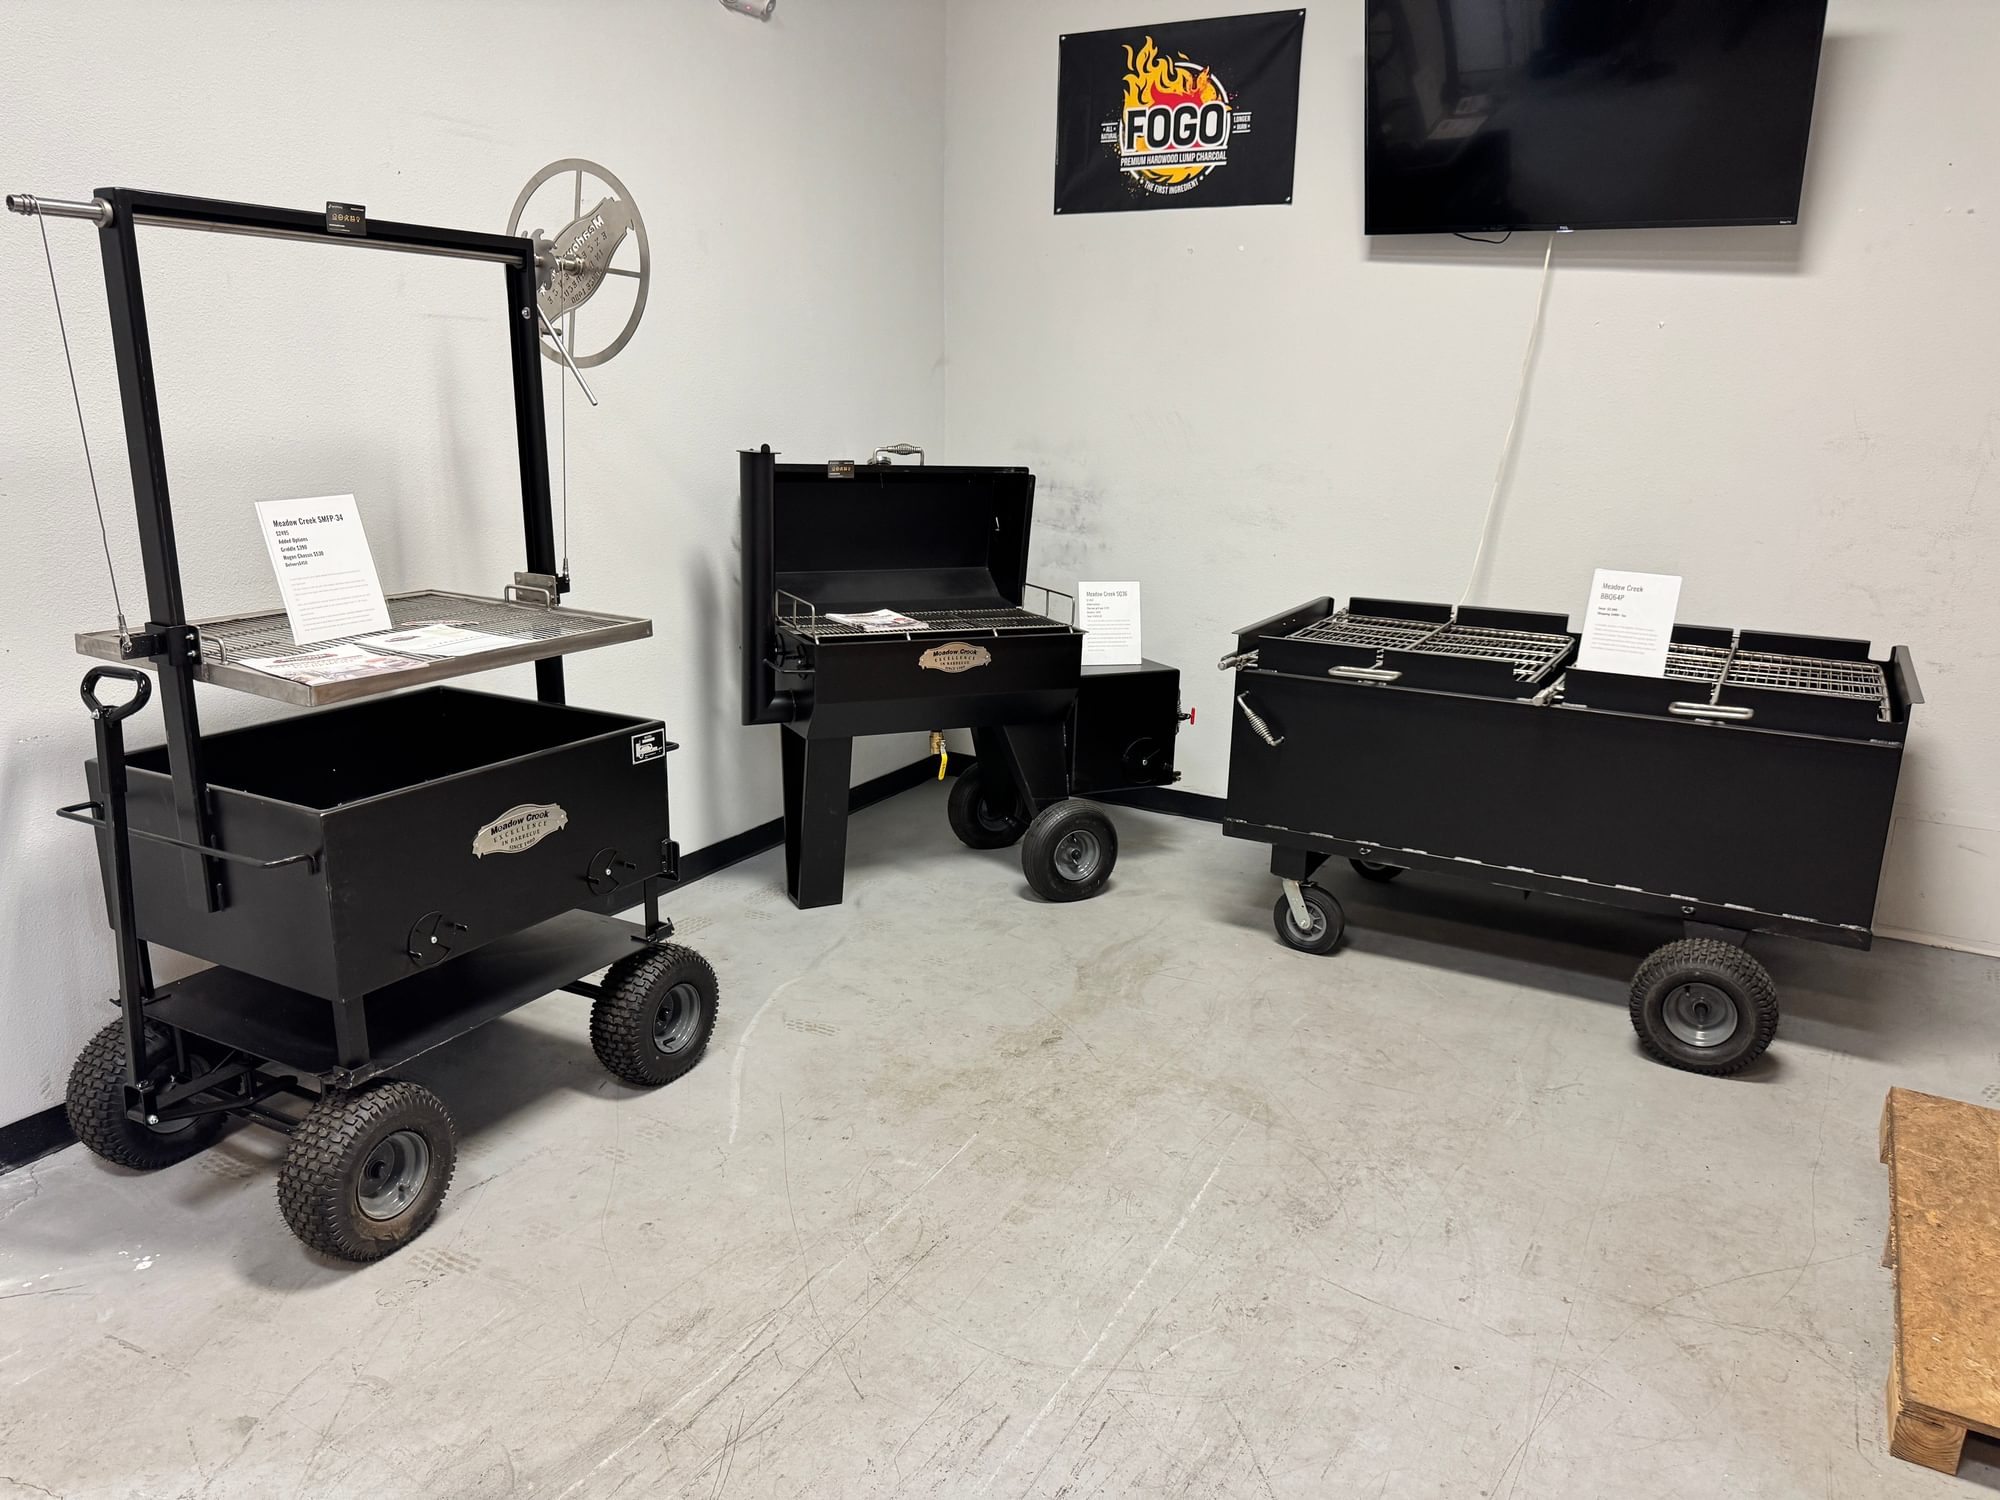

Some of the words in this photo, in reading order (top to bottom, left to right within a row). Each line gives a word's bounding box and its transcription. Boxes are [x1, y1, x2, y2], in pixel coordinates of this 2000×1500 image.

[1125, 103, 1225, 150] FOGO
[1120, 157, 1147, 167] PREMIUM
[1147, 154, 1178, 165] HARDWOOD
[1179, 152, 1196, 163] LUMP
[1196, 150, 1227, 162] CHARCOAL
[1144, 181, 1154, 192] THE
[1153, 185, 1169, 195] FIRST
[1168, 178, 1199, 195] INGREDIENT
[273, 519, 298, 527] Meadow
[298, 517, 317, 525] Creek
[1603, 582, 1625, 590] Meadow
[1627, 584, 1643, 592] Creek
[1600, 592, 1625, 600] BBQ64P
[490, 817, 524, 835] Meadow
[526, 810, 550, 821] Creek
[493, 821, 546, 843] EXCELLENCE
[510, 829, 540, 843] BARBECUE
